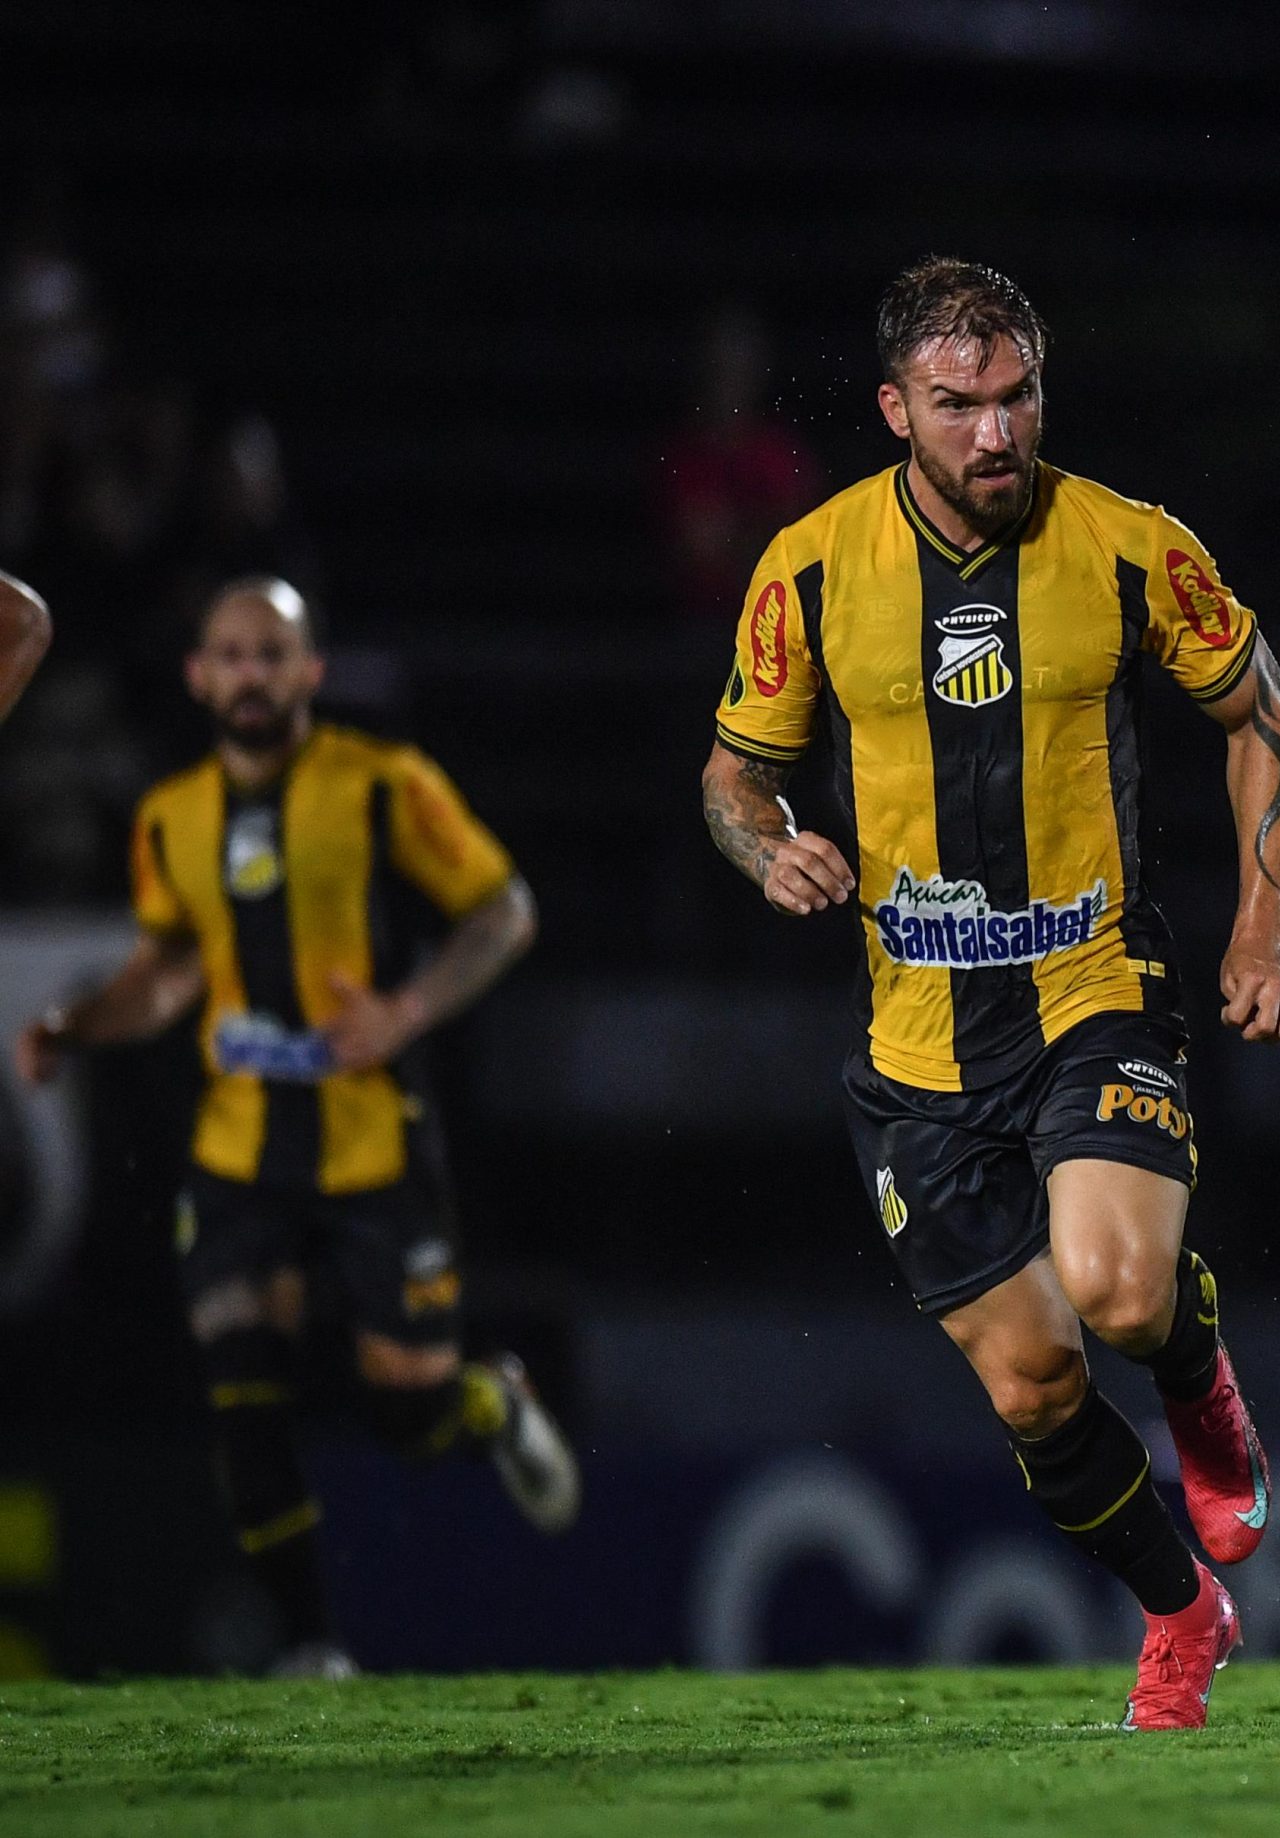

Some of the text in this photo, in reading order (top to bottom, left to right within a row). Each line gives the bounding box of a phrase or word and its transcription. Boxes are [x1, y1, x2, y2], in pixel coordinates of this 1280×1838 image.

[942, 613, 999, 626] PHYSICUS
[1171, 560, 1225, 636] Kodilar
[894, 871, 983, 912] Açúcar
[1096, 1084, 1187, 1139] Poty
